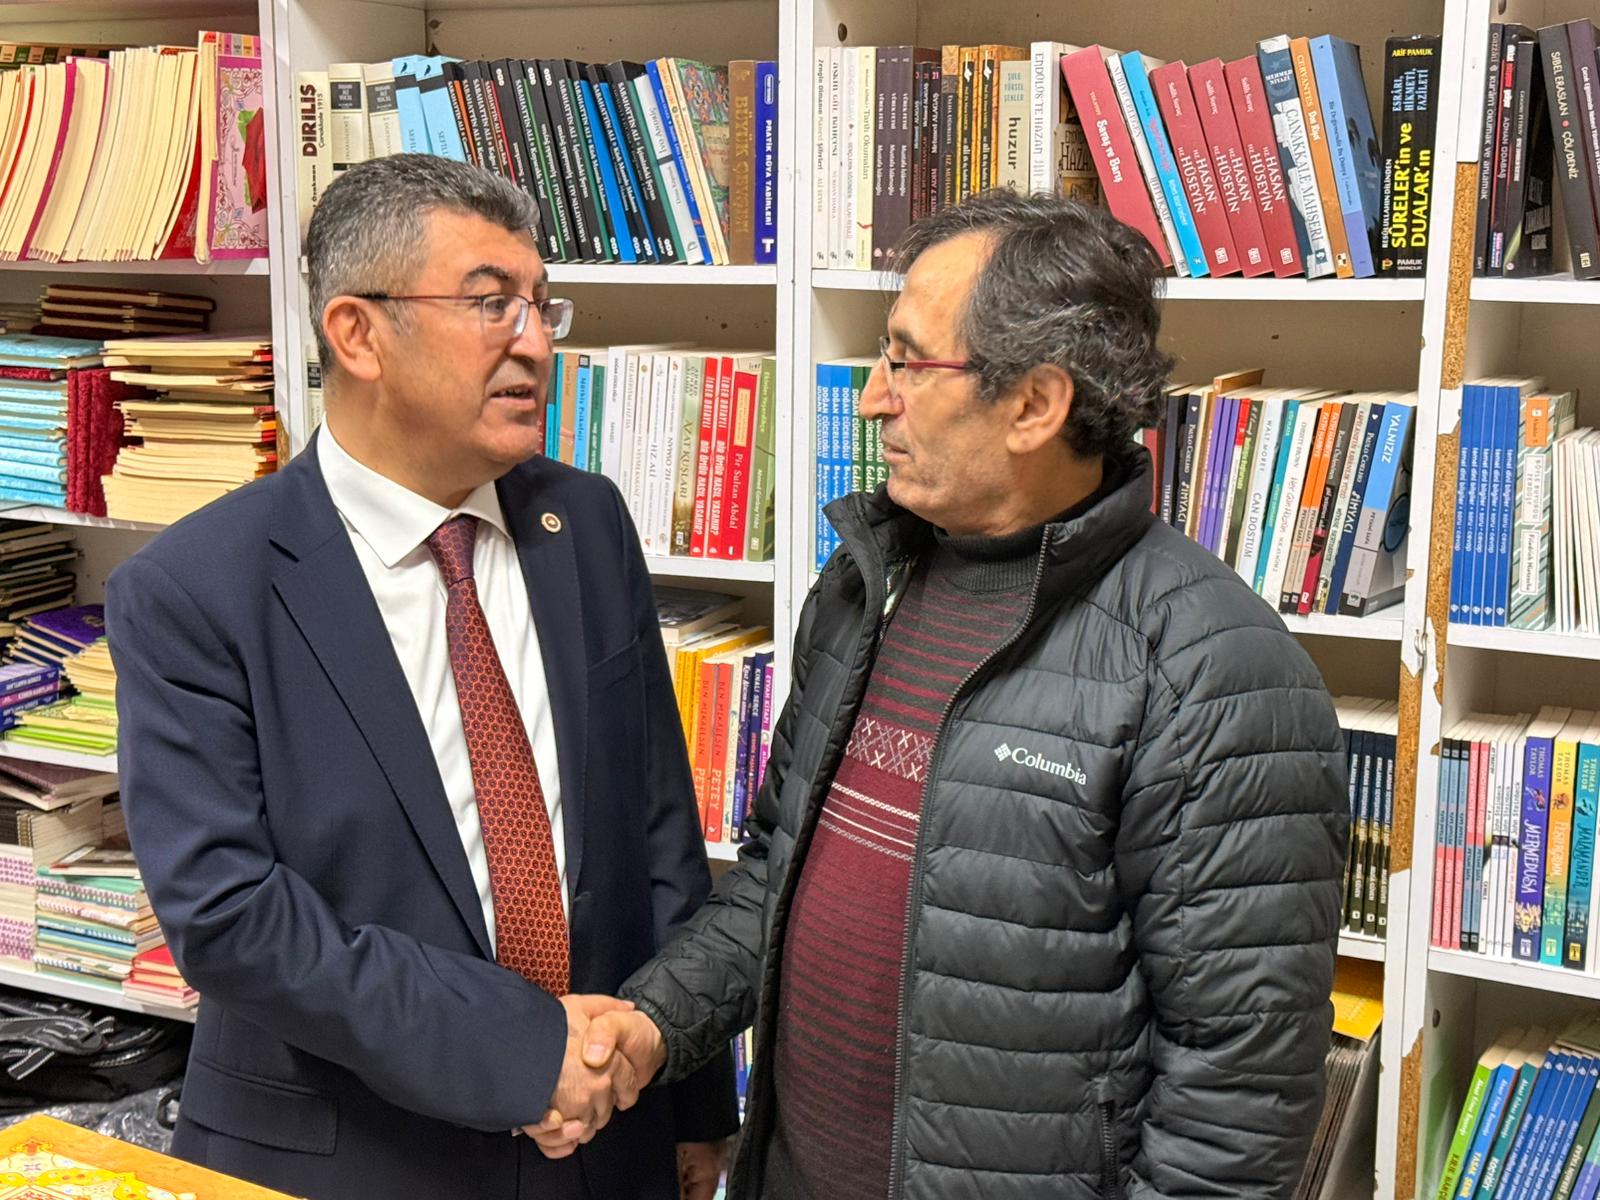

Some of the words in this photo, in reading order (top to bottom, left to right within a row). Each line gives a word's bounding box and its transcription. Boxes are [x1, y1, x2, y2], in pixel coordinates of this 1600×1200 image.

[1406, 48, 1433, 56] PAMUK
[1555, 75, 1568, 115] ERASLAN
[1007, 117, 1021, 170] huzur
[1483, 109, 1494, 144] okumak
[1105, 145, 1117, 157] ve
[1109, 157, 1126, 182] Barış
[1482, 146, 1491, 158] ve
[1180, 155, 1207, 212] HÜSEYİN
[1195, 158, 1219, 201] HASAN
[1215, 155, 1242, 212] HÜSEYİN
[1230, 156, 1254, 199] HASAN
[1250, 153, 1276, 210] HÜSEYİN
[1265, 154, 1287, 198] HASAN
[1388, 148, 1411, 248] SÛRELER'in
[1400, 123, 1412, 145] ve
[1479, 160, 1490, 199] anlamak
[1381, 412, 1401, 464] YALNIZIZ
[731, 469, 742, 499] Sultan
[1251, 492, 1262, 514] CAN
[728, 501, 739, 528] Abdal
[1244, 516, 1258, 558] DOSTUM
[1499, 533, 1507, 553] cevap
[1011, 747, 1087, 785] Columbia
[708, 769, 722, 810] PETEY
[1521, 819, 1541, 893] MERMEDUSA
